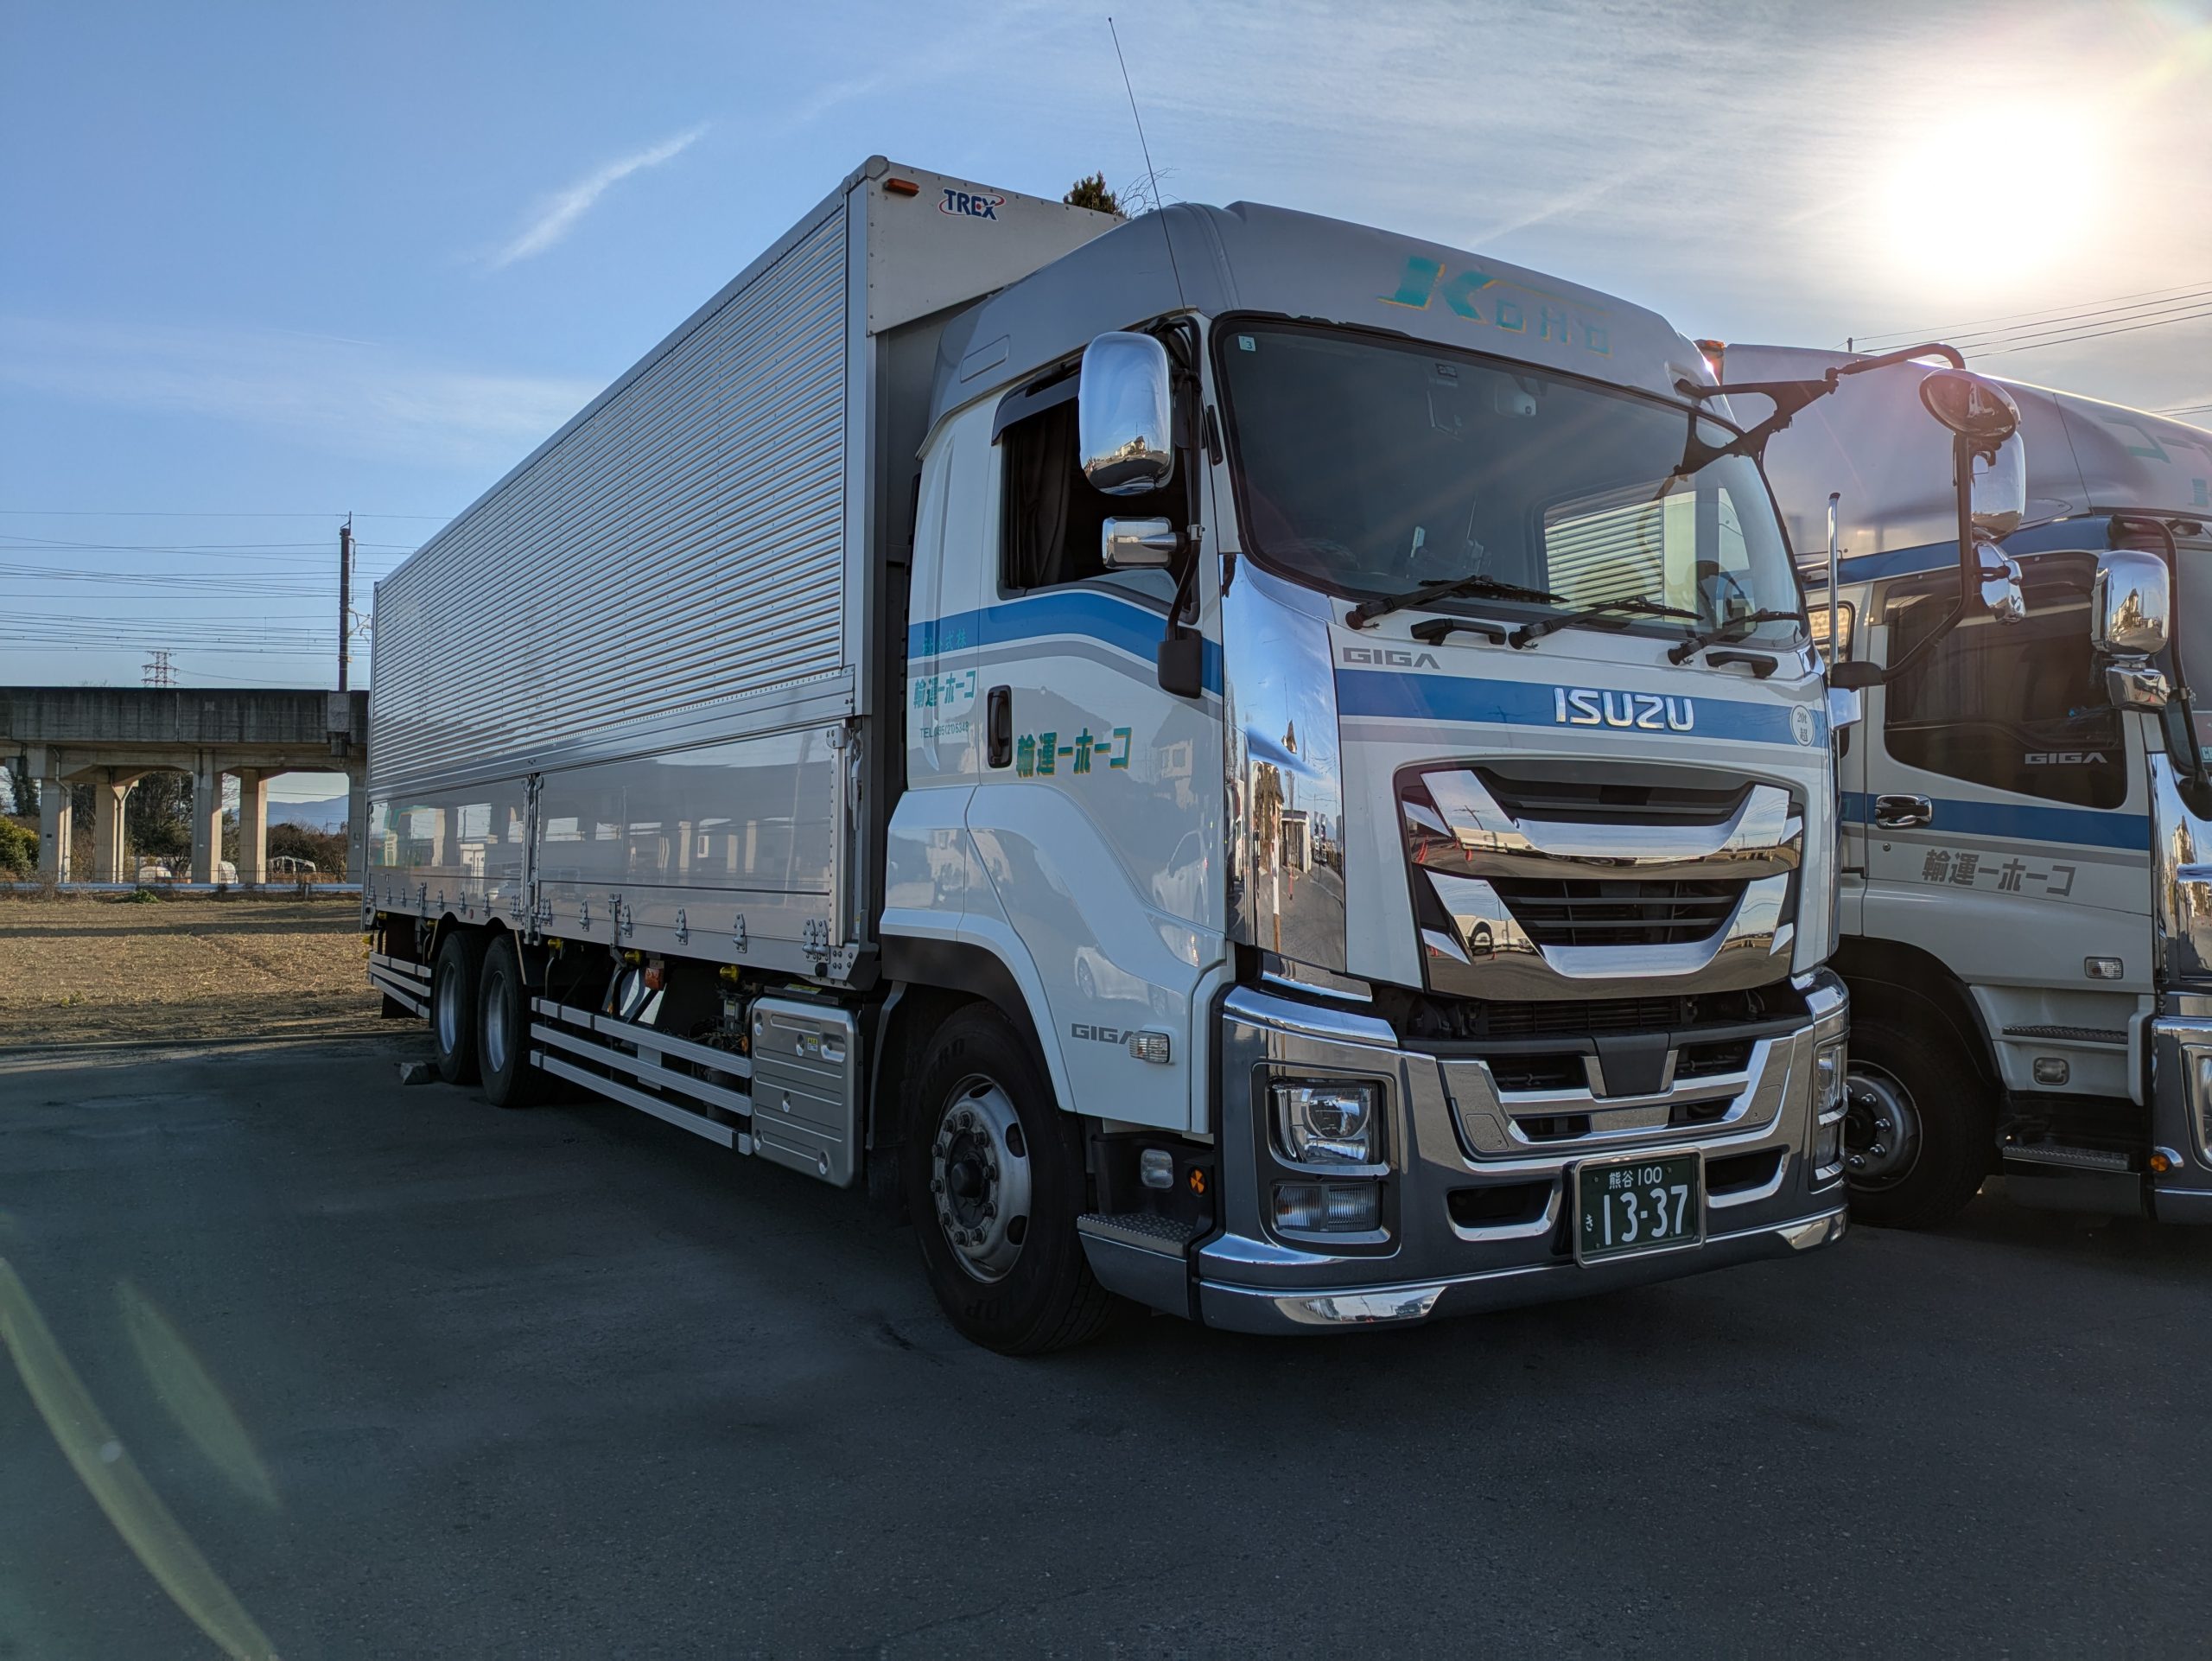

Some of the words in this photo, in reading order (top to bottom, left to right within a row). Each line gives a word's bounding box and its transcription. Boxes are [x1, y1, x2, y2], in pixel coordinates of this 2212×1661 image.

[943, 188, 997, 220] TREX
[1343, 646, 1441, 670] GIGA
[1554, 687, 1694, 732] ISUZU
[2024, 752, 2108, 765] GIGA
[1608, 1170, 1634, 1190] 熊谷
[1637, 1166, 1662, 1187] 100
[1604, 1184, 1688, 1245] 13-37
